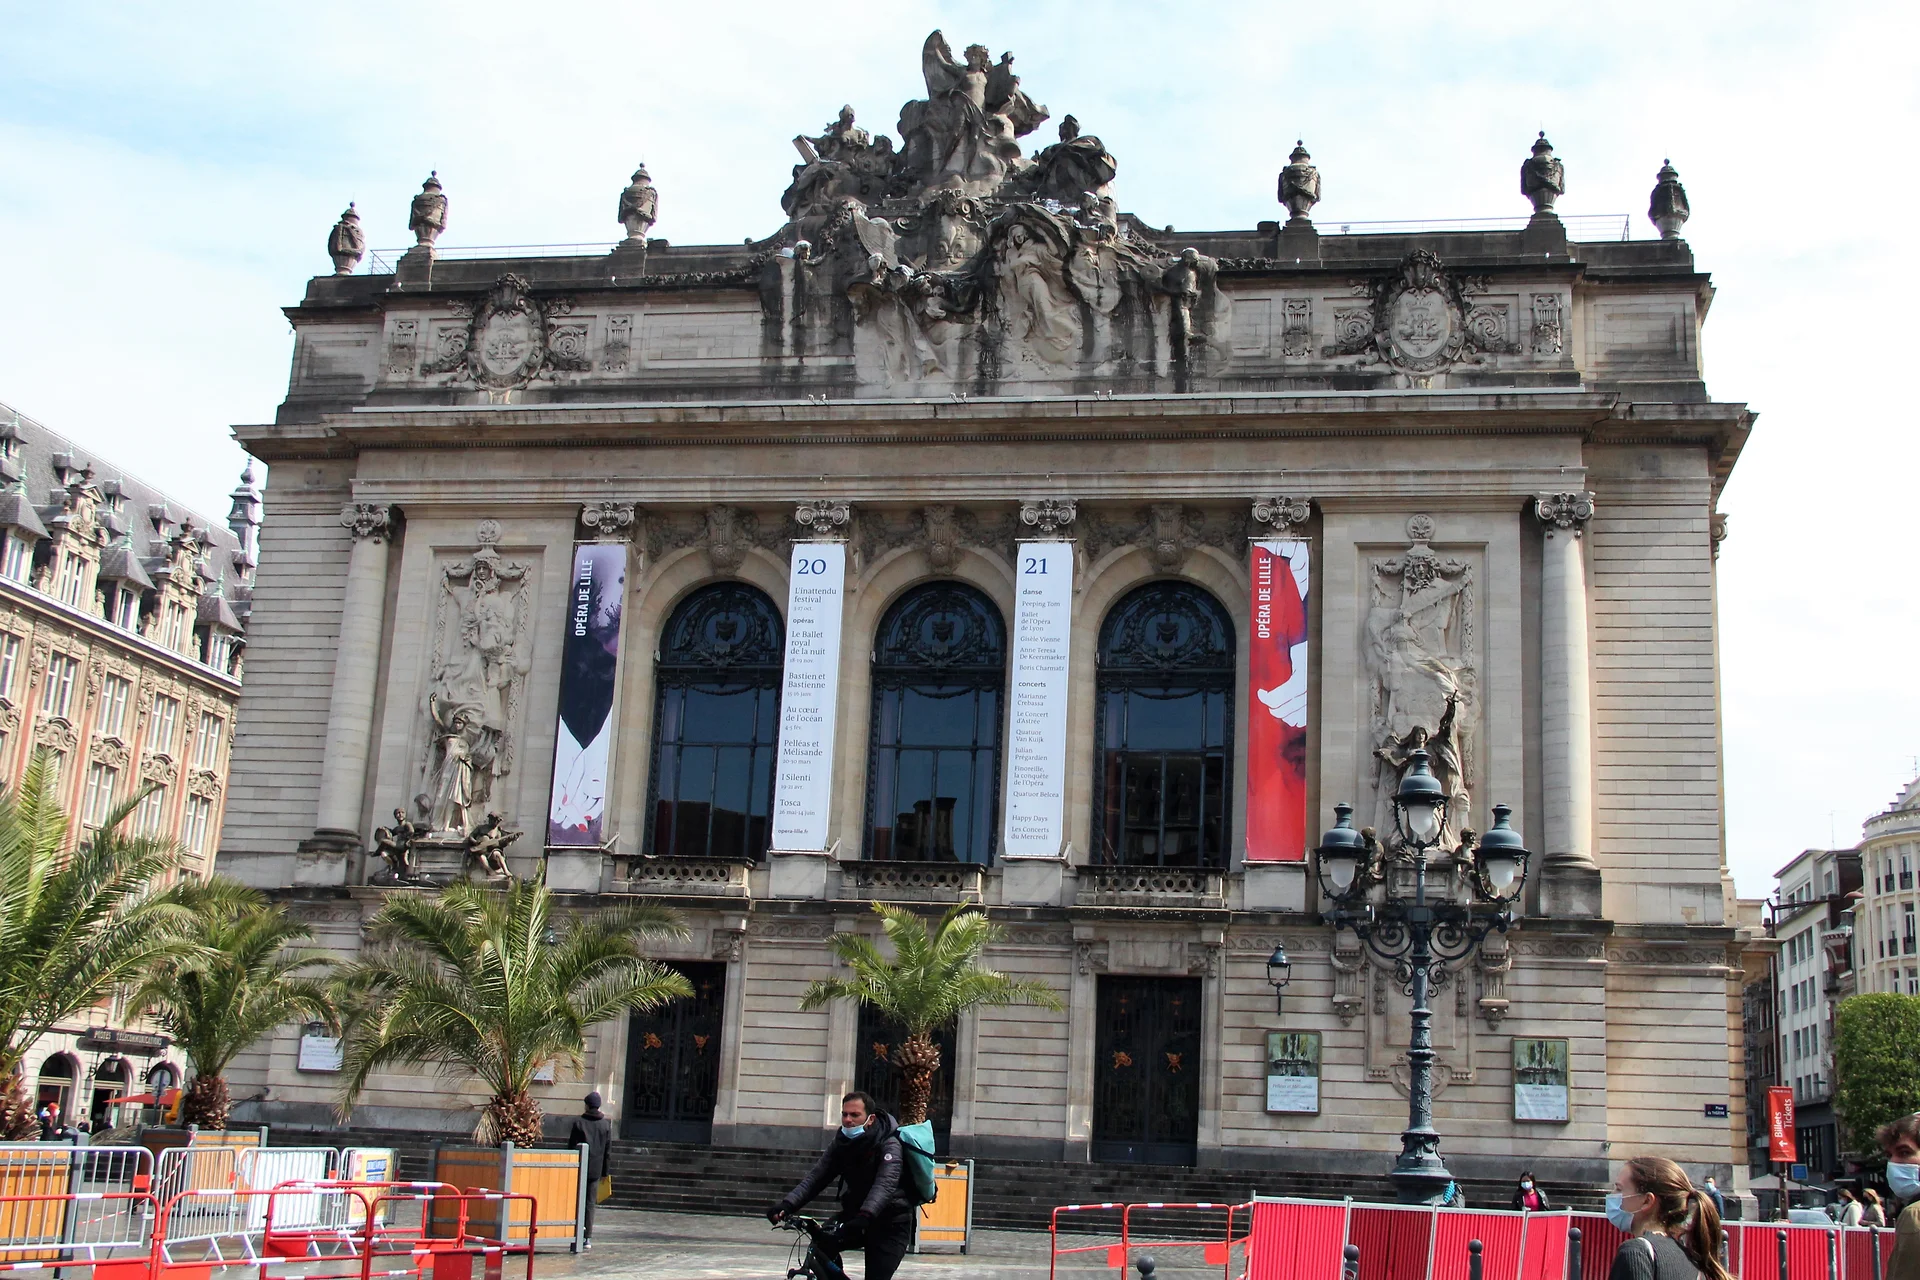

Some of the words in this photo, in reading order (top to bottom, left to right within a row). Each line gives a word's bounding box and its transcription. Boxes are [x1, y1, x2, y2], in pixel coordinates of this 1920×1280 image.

[580, 560, 592, 585] LILLE
[797, 559, 826, 575] 20
[1025, 558, 1048, 574] 21
[1259, 558, 1271, 584] LILLE
[578, 588, 590, 601] DE
[1258, 588, 1271, 601] DE
[574, 603, 588, 637] OPÉRA
[1256, 604, 1270, 638] OPÉRA
[784, 739, 811, 747] Pelléas
[1774, 1111, 1783, 1138] Billets
[1784, 1099, 1792, 1128] Tickets
